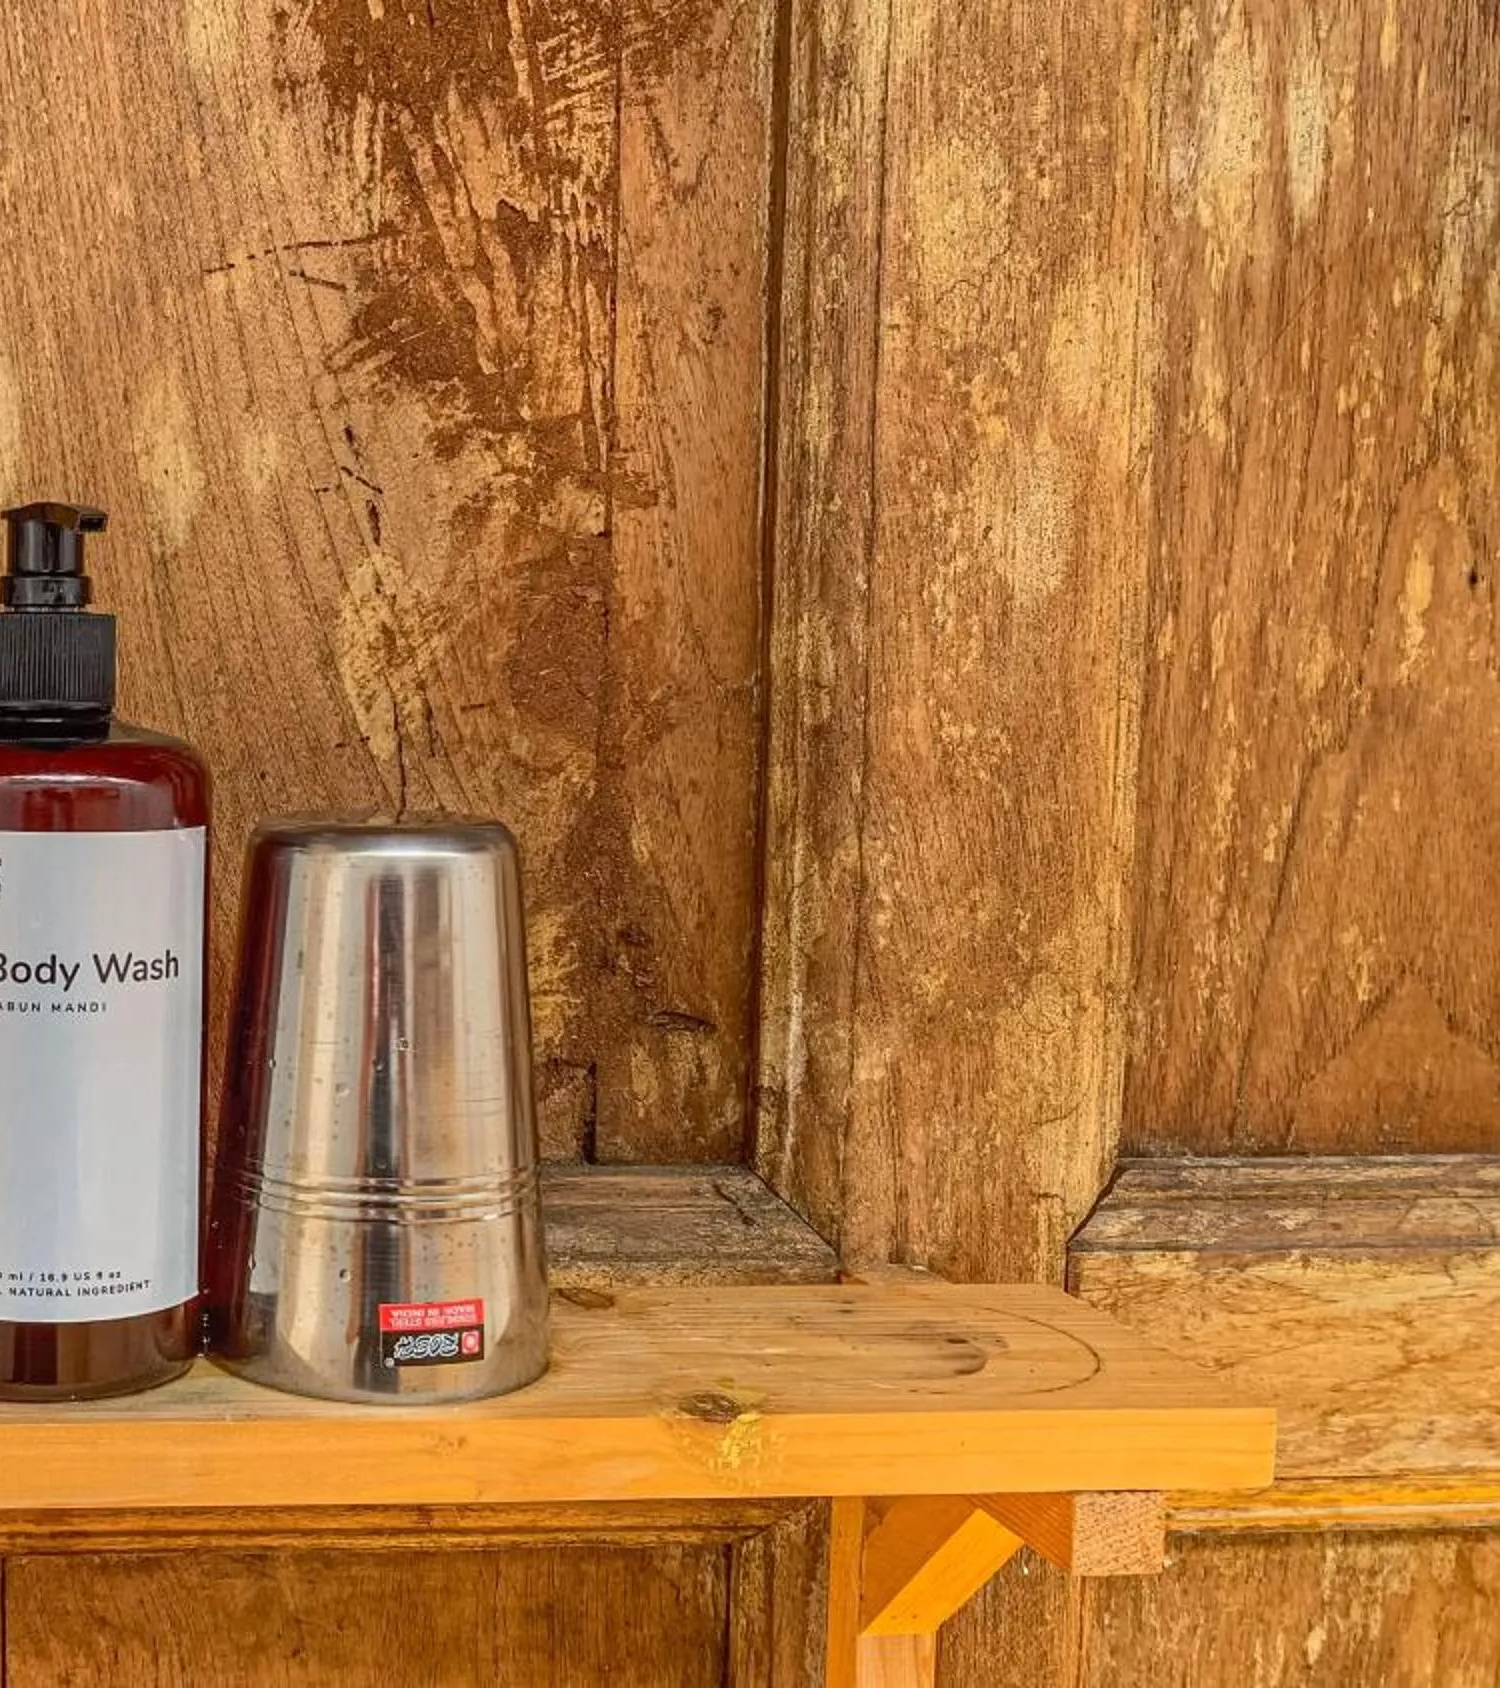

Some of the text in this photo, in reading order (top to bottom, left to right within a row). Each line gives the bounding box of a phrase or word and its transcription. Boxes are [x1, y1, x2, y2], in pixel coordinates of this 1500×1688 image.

[92, 949, 180, 984] Wash
[51, 1002, 107, 1013] MANDI
[8, 1272, 23, 1281] ml
[73, 1272, 91, 1281] US
[9, 1286, 72, 1297] NATURAL
[77, 1279, 151, 1297] INGREDIENT
